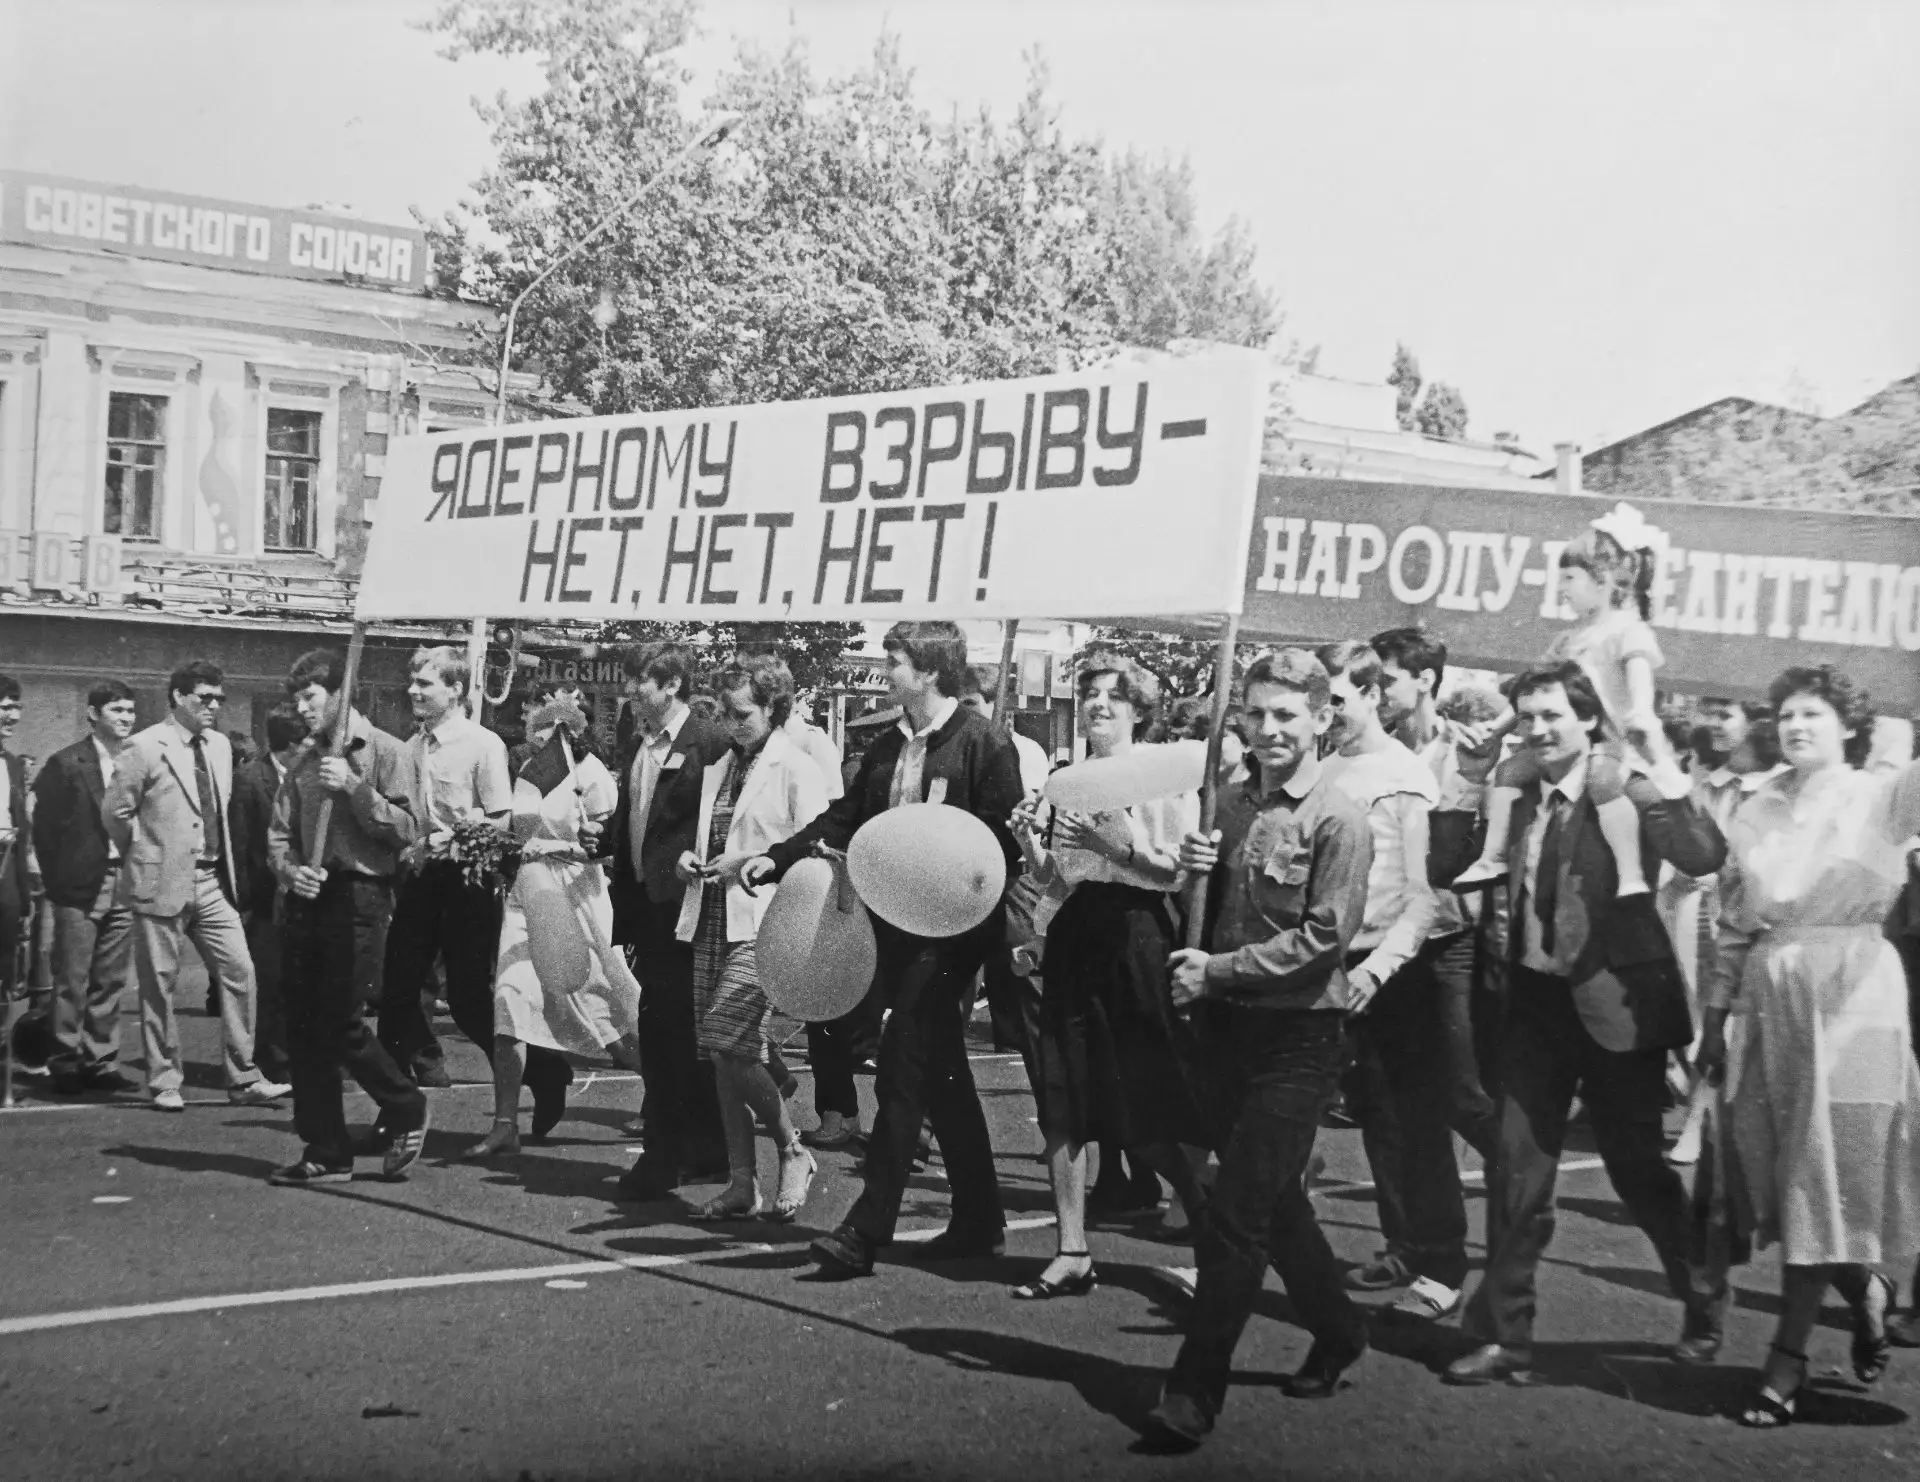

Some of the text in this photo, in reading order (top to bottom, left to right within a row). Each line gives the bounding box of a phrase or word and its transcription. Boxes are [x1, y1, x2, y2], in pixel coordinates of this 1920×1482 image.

[25, 184, 271, 262] СОВЕТСКОГО
[425, 421, 738, 522] ЯДЕРНОМУ
[519, 501, 999, 615] НЕТ, НЕТ, НЕТ!
